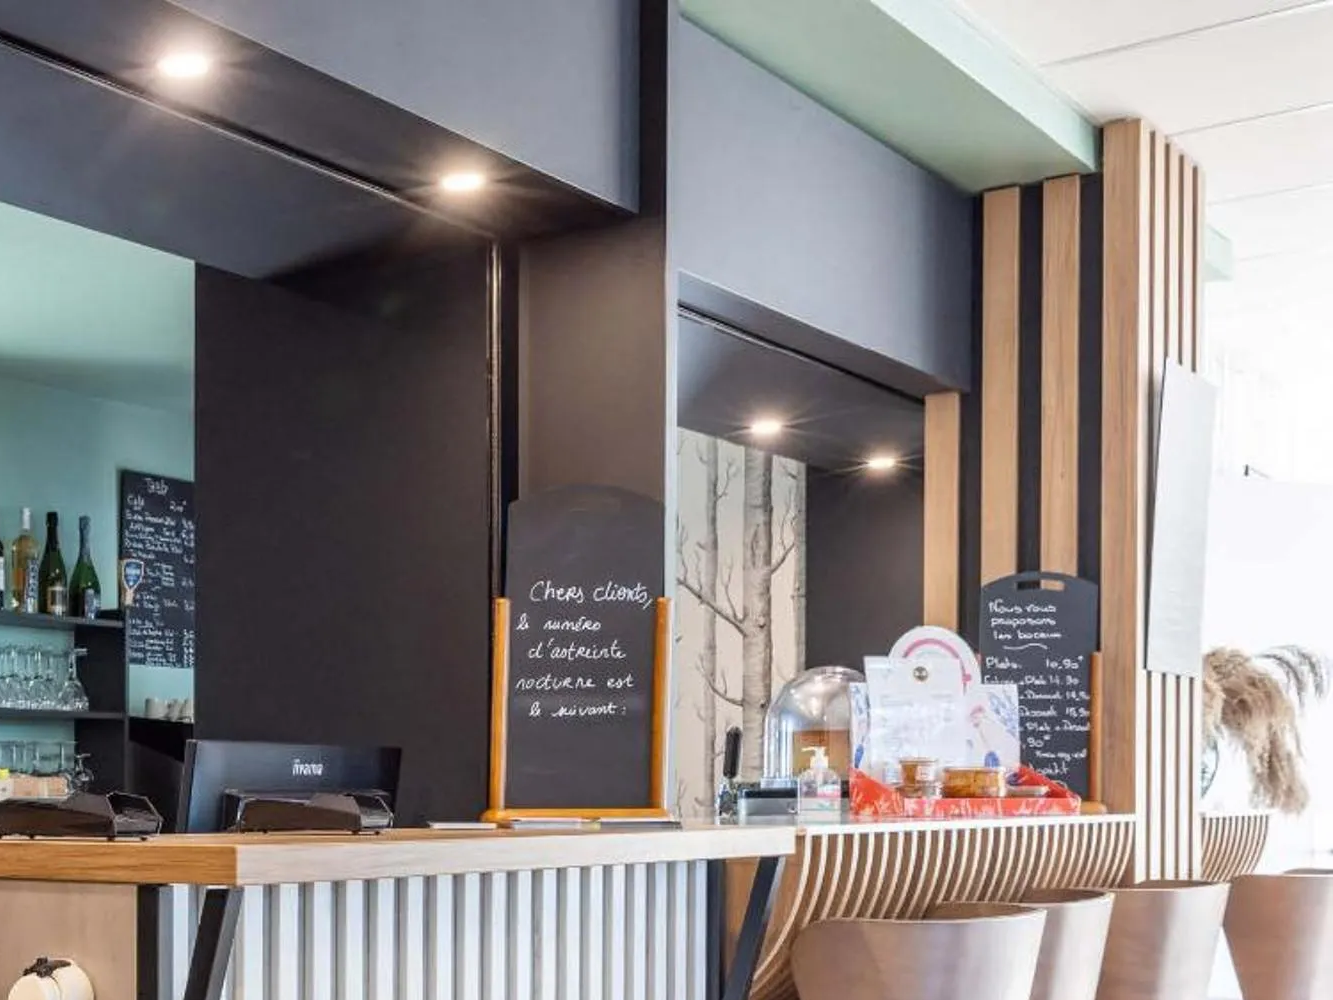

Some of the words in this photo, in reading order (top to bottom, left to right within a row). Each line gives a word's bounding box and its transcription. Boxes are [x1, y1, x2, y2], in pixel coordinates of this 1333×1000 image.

[529, 580, 584, 604] Chers
[592, 581, 653, 610] clients,
[988, 598, 1023, 614] Nous
[543, 616, 602, 632] numéro
[527, 638, 627, 661] d'astreinte
[515, 673, 597, 690] nocturne
[606, 673, 635, 689] est
[529, 701, 542, 718] le
